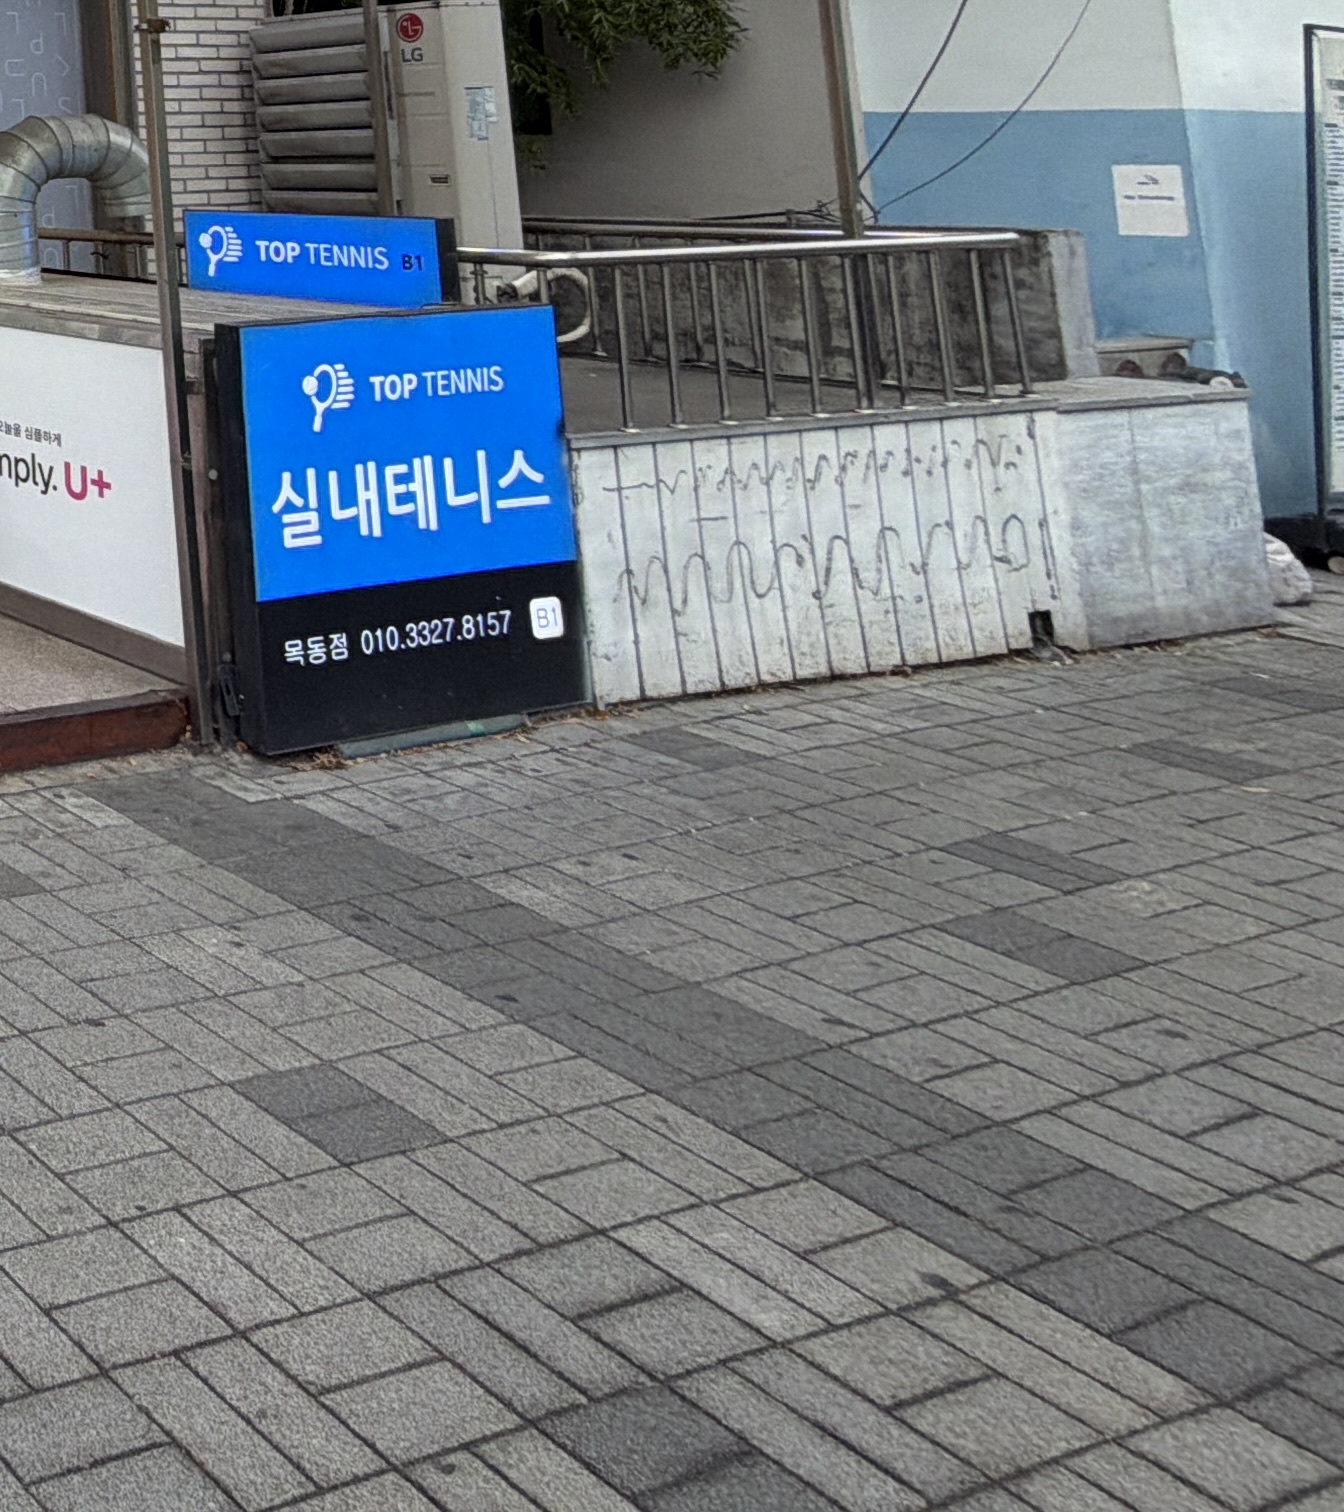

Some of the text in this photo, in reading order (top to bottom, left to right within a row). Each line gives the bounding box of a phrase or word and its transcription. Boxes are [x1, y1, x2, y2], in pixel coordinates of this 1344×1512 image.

[401, 47, 424, 63] LG
[256, 239, 424, 273] TOP TENNIS B1
[369, 365, 504, 402] TOP TENNIS
[24, 426, 62, 448] 심플하게
[64, 461, 112, 501] U+
[272, 449, 551, 549] 실내테니스
[284, 607, 560, 668] 목동점 010.3327.8157 B1
